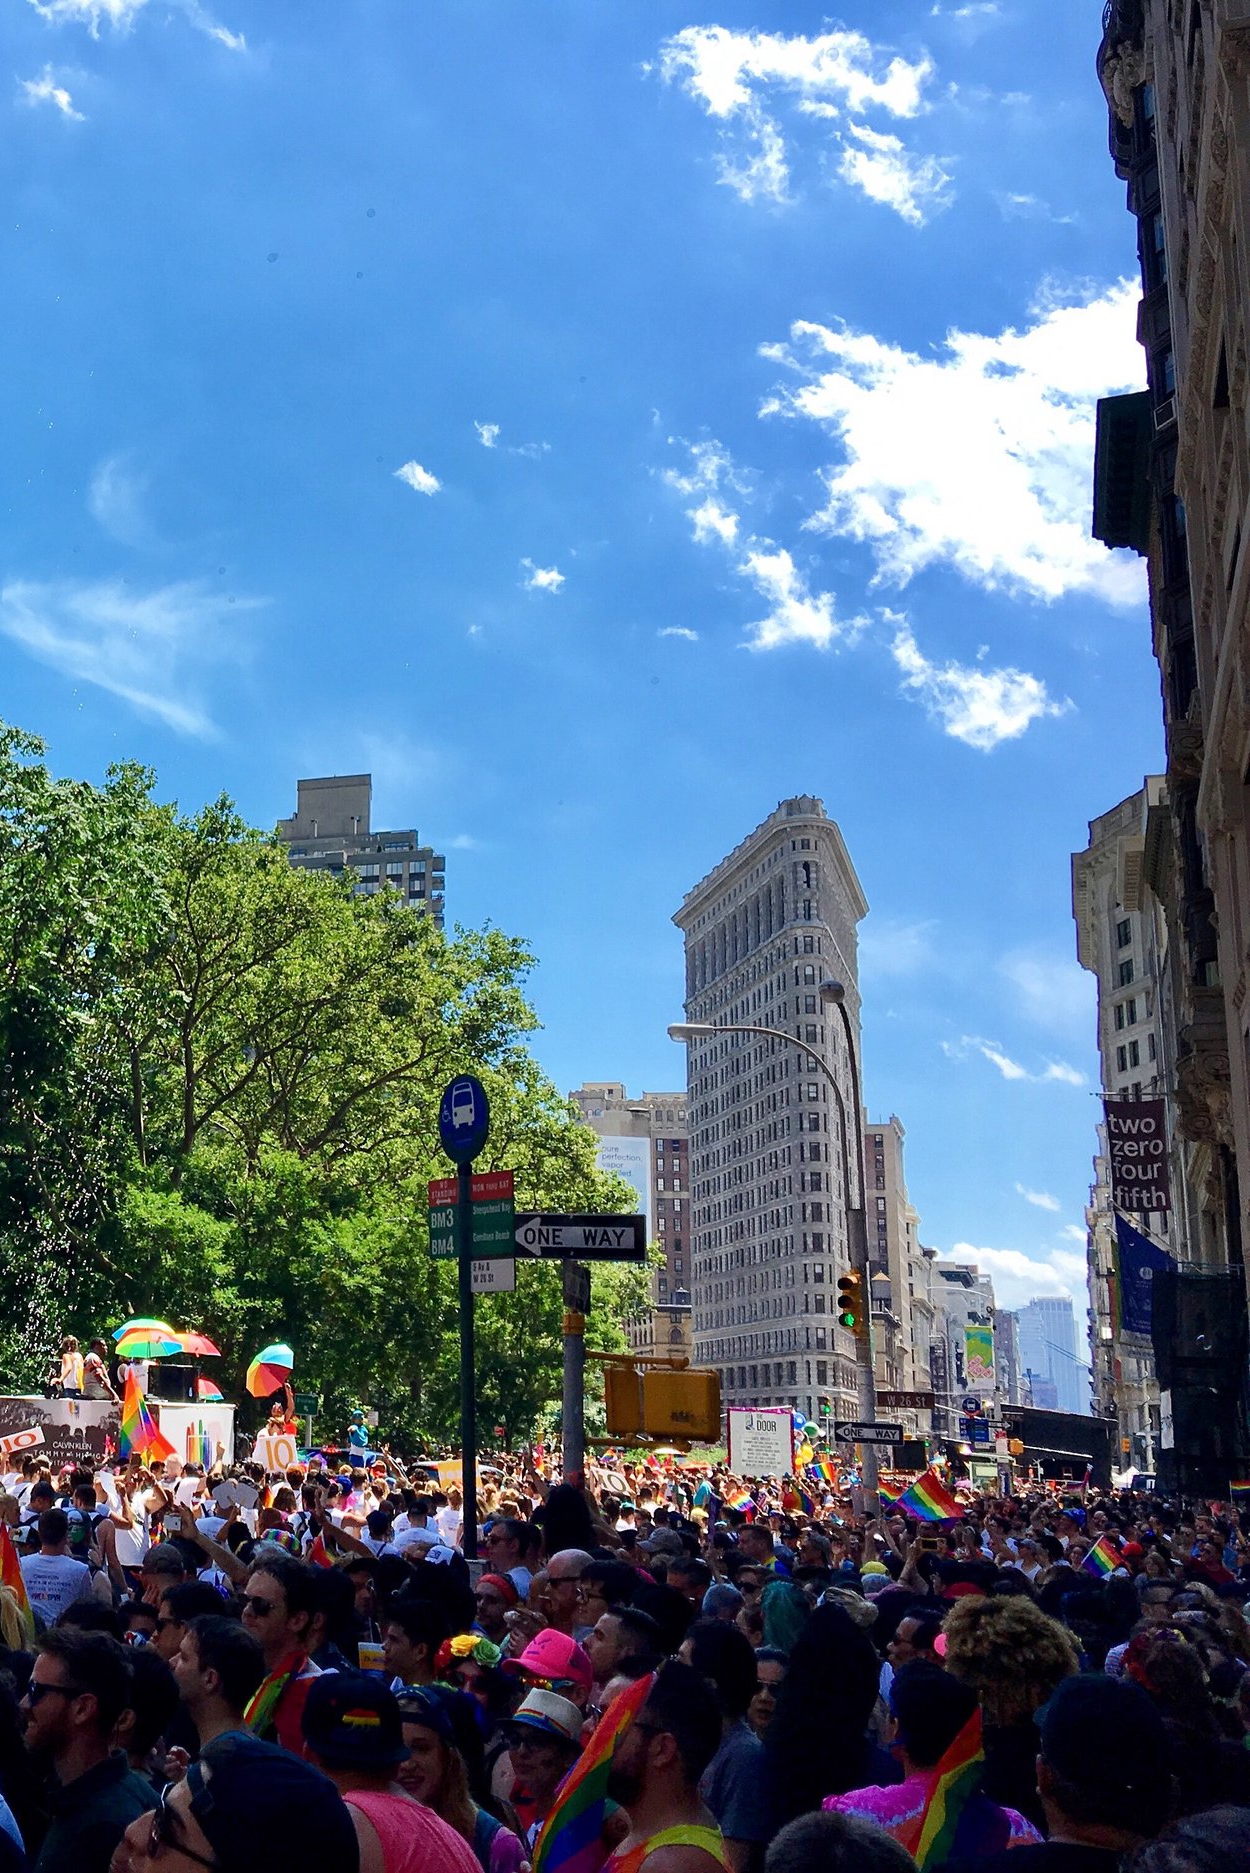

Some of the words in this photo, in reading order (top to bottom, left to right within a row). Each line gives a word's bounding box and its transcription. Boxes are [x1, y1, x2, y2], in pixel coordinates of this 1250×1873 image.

[1108, 1113, 1156, 1134] two
[1112, 1140, 1164, 1157] zero
[1112, 1157, 1162, 1180] four
[1114, 1185, 1167, 1208] fifth
[431, 1208, 454, 1228] BM3
[432, 1235, 454, 1255] BM4
[524, 1228, 563, 1246] ONE
[582, 1228, 626, 1246] WAY
[473, 1274, 479, 1283] W
[480, 1274, 487, 1283] 26
[488, 1274, 494, 1283] St
[887, 1396, 896, 1405] W
[900, 1396, 911, 1407] 26
[916, 1396, 926, 1407] St
[757, 1420, 777, 1432] DOOR
[843, 1428, 864, 1437] ONE
[875, 1430, 898, 1439] WAY
[3, 1433, 37, 1453] 10
[52, 1442, 74, 1450] CALVIN
[266, 1438, 294, 1470] 10
